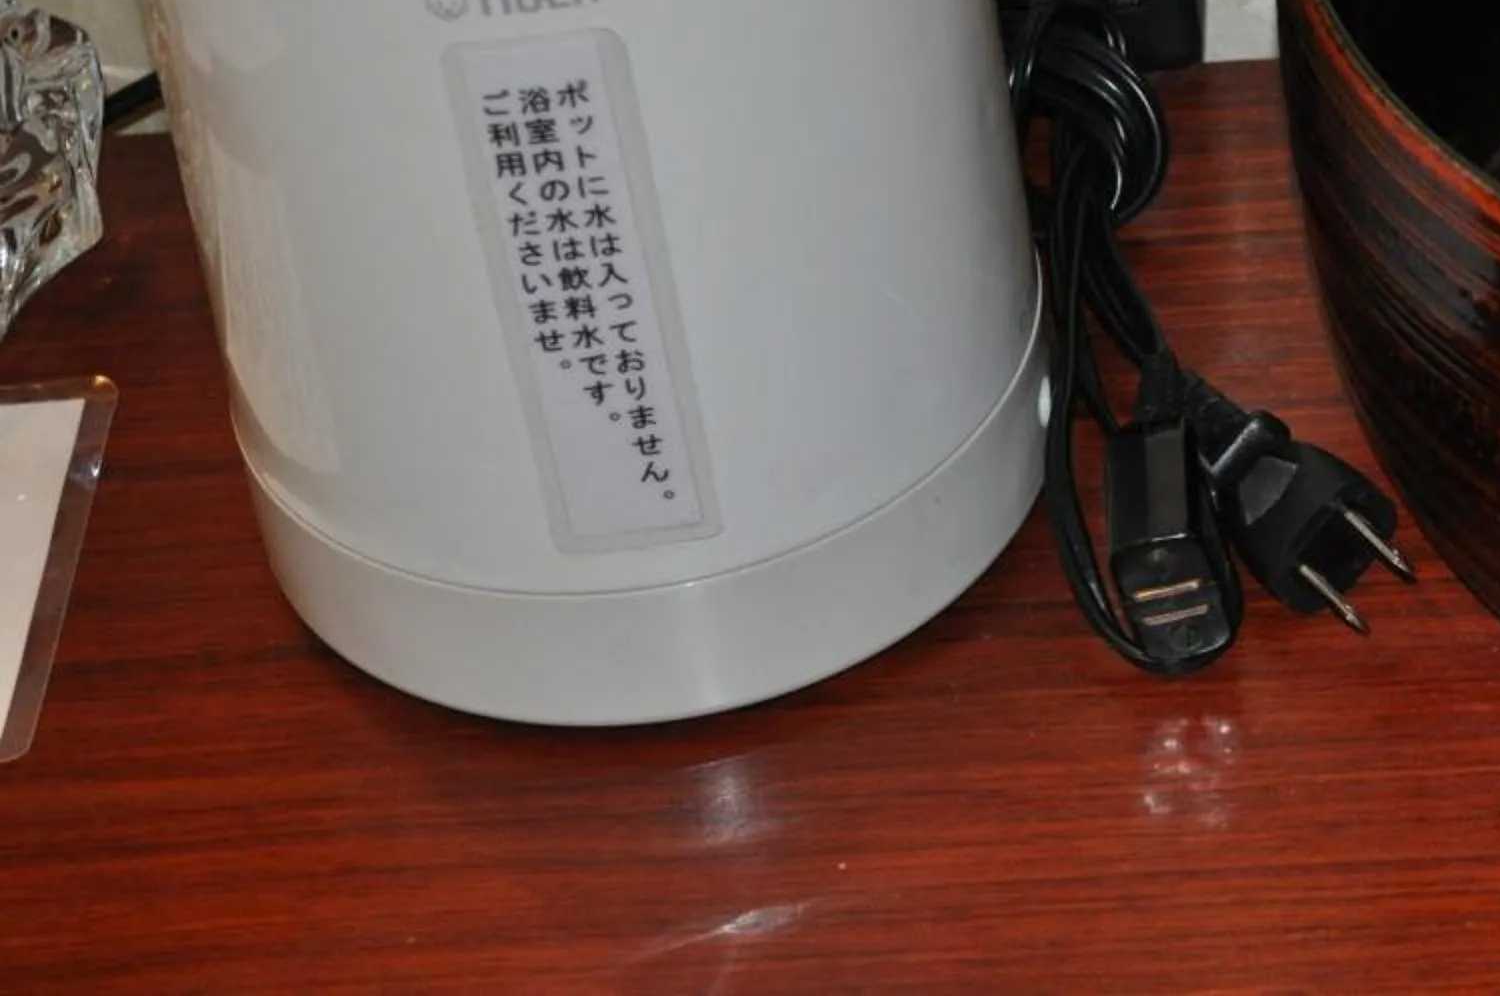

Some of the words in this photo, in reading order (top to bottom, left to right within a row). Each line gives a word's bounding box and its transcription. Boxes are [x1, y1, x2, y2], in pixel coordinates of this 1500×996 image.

[482, 89, 572, 370] ご利用くださいませ。
[518, 86, 621, 423] 浴室内の水は飲料水です。
[556, 79, 677, 501] ポットに水は入っておりません。
